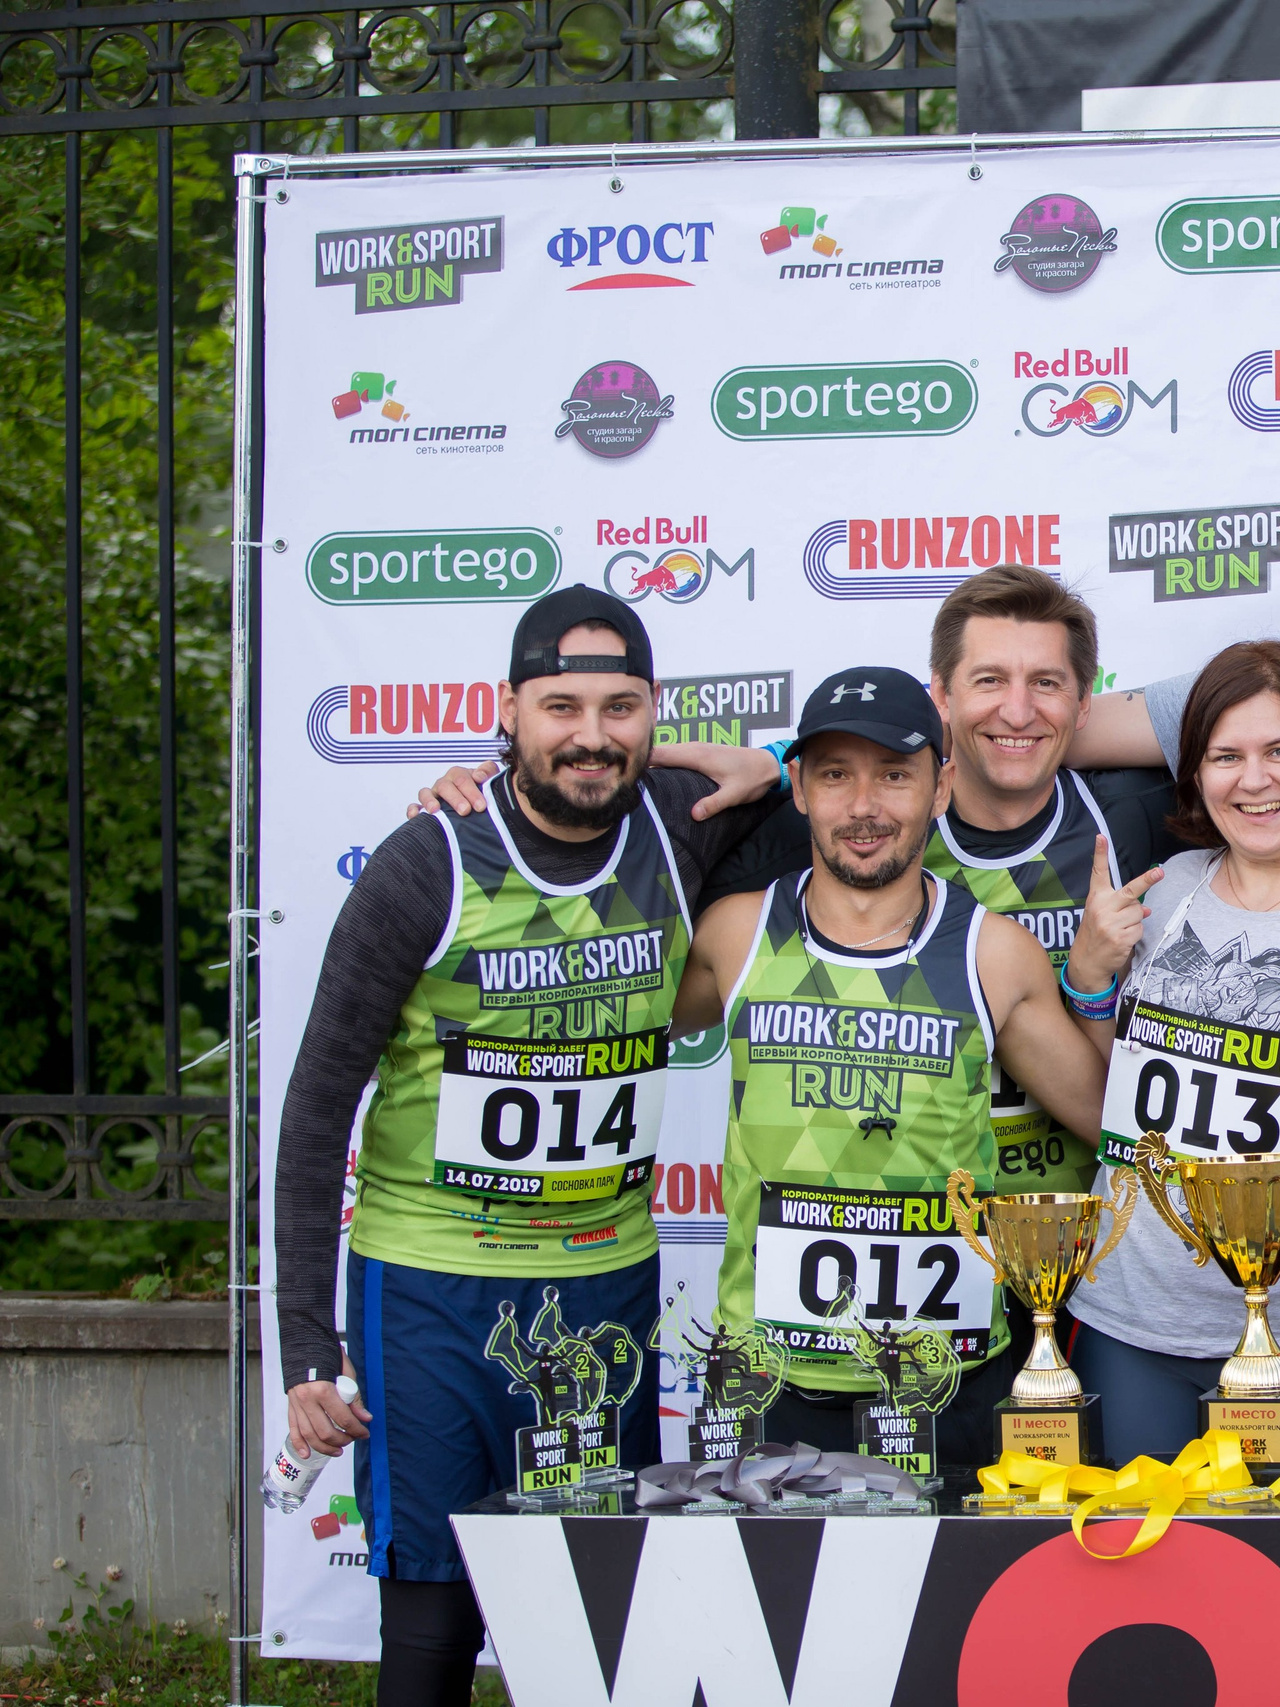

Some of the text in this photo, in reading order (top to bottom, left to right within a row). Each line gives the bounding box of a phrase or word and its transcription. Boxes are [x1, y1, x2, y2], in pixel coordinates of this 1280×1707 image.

[320, 223, 497, 274] WORK&SPORT
[546, 221, 715, 268] ФРОСТ
[779, 259, 944, 279] mori cinema
[1028, 260, 1085, 271] студия загара
[1043, 269, 1077, 278] красоты
[365, 264, 455, 308] RUN
[849, 279, 941, 291] сеть кинотеатров
[1014, 347, 1128, 378] Red Bull
[735, 376, 953, 431] sportego
[350, 425, 507, 443] mori cinema
[587, 427, 642, 437] студия загара
[601, 435, 635, 443] красоты
[416, 444, 504, 455] сеть кинотеатров
[597, 515, 707, 546] Red Bull
[849, 514, 1060, 570] RUNZONE
[330, 542, 537, 596] sportego
[1166, 551, 1260, 595] RUN
[479, 930, 663, 990] WORK&SPORT
[486, 975, 659, 1005] ПЕРВЫЙ КОРПОРАТИВНЫЙ ЗАБЕГ
[533, 996, 625, 1039] RUN
[1134, 1006, 1224, 1036] КОРПОРАТИВНЫЙ ЗАБЕГ
[751, 1004, 958, 1057] WORK&SPORT
[1131, 1016, 1223, 1060] WORK&SPORT
[467, 1039, 586, 1054] КОРПОРАТИВНЫЙ ЗАБЕГ
[467, 1049, 585, 1077] WORK&SPORT
[586, 1035, 655, 1075] RUN
[753, 1047, 948, 1071] ПЕРВЫЙ КОРПОРАТИВНЫЙ ЗАБЕГ
[796, 1065, 898, 1109] RUN
[481, 1082, 637, 1162] 014
[995, 1121, 1031, 1137] СОСНОВКА
[446, 1169, 541, 1193] 14.07.2019
[551, 1175, 615, 1191] СОСНОВКА ПАРК
[782, 1189, 901, 1206] КОРПОРАТИВНЫЙ ЗАБЕГ
[782, 1200, 901, 1230] WORK&SPORT
[572, 1225, 618, 1244] RUNZONE
[479, 1241, 539, 1250] mori cinema
[799, 1239, 960, 1320] 012
[614, 1338, 627, 1357] 2
[928, 1347, 940, 1364] 3
[576, 1353, 589, 1372] 2
[752, 1350, 763, 1367] 1
[800, 1357, 837, 1365] cinema
[1025, 1419, 1067, 1429] место
[1231, 1410, 1276, 1419] место
[701, 1422, 742, 1440] WORK&
[878, 1418, 917, 1434] WORK&
[532, 1429, 568, 1448] WORK&
[882, 1438, 914, 1453] SPORT
[536, 1449, 566, 1467] SPORT
[704, 1442, 739, 1459] SPORT
[1025, 1446, 1056, 1454] WORK
[533, 1468, 571, 1488] RUN
